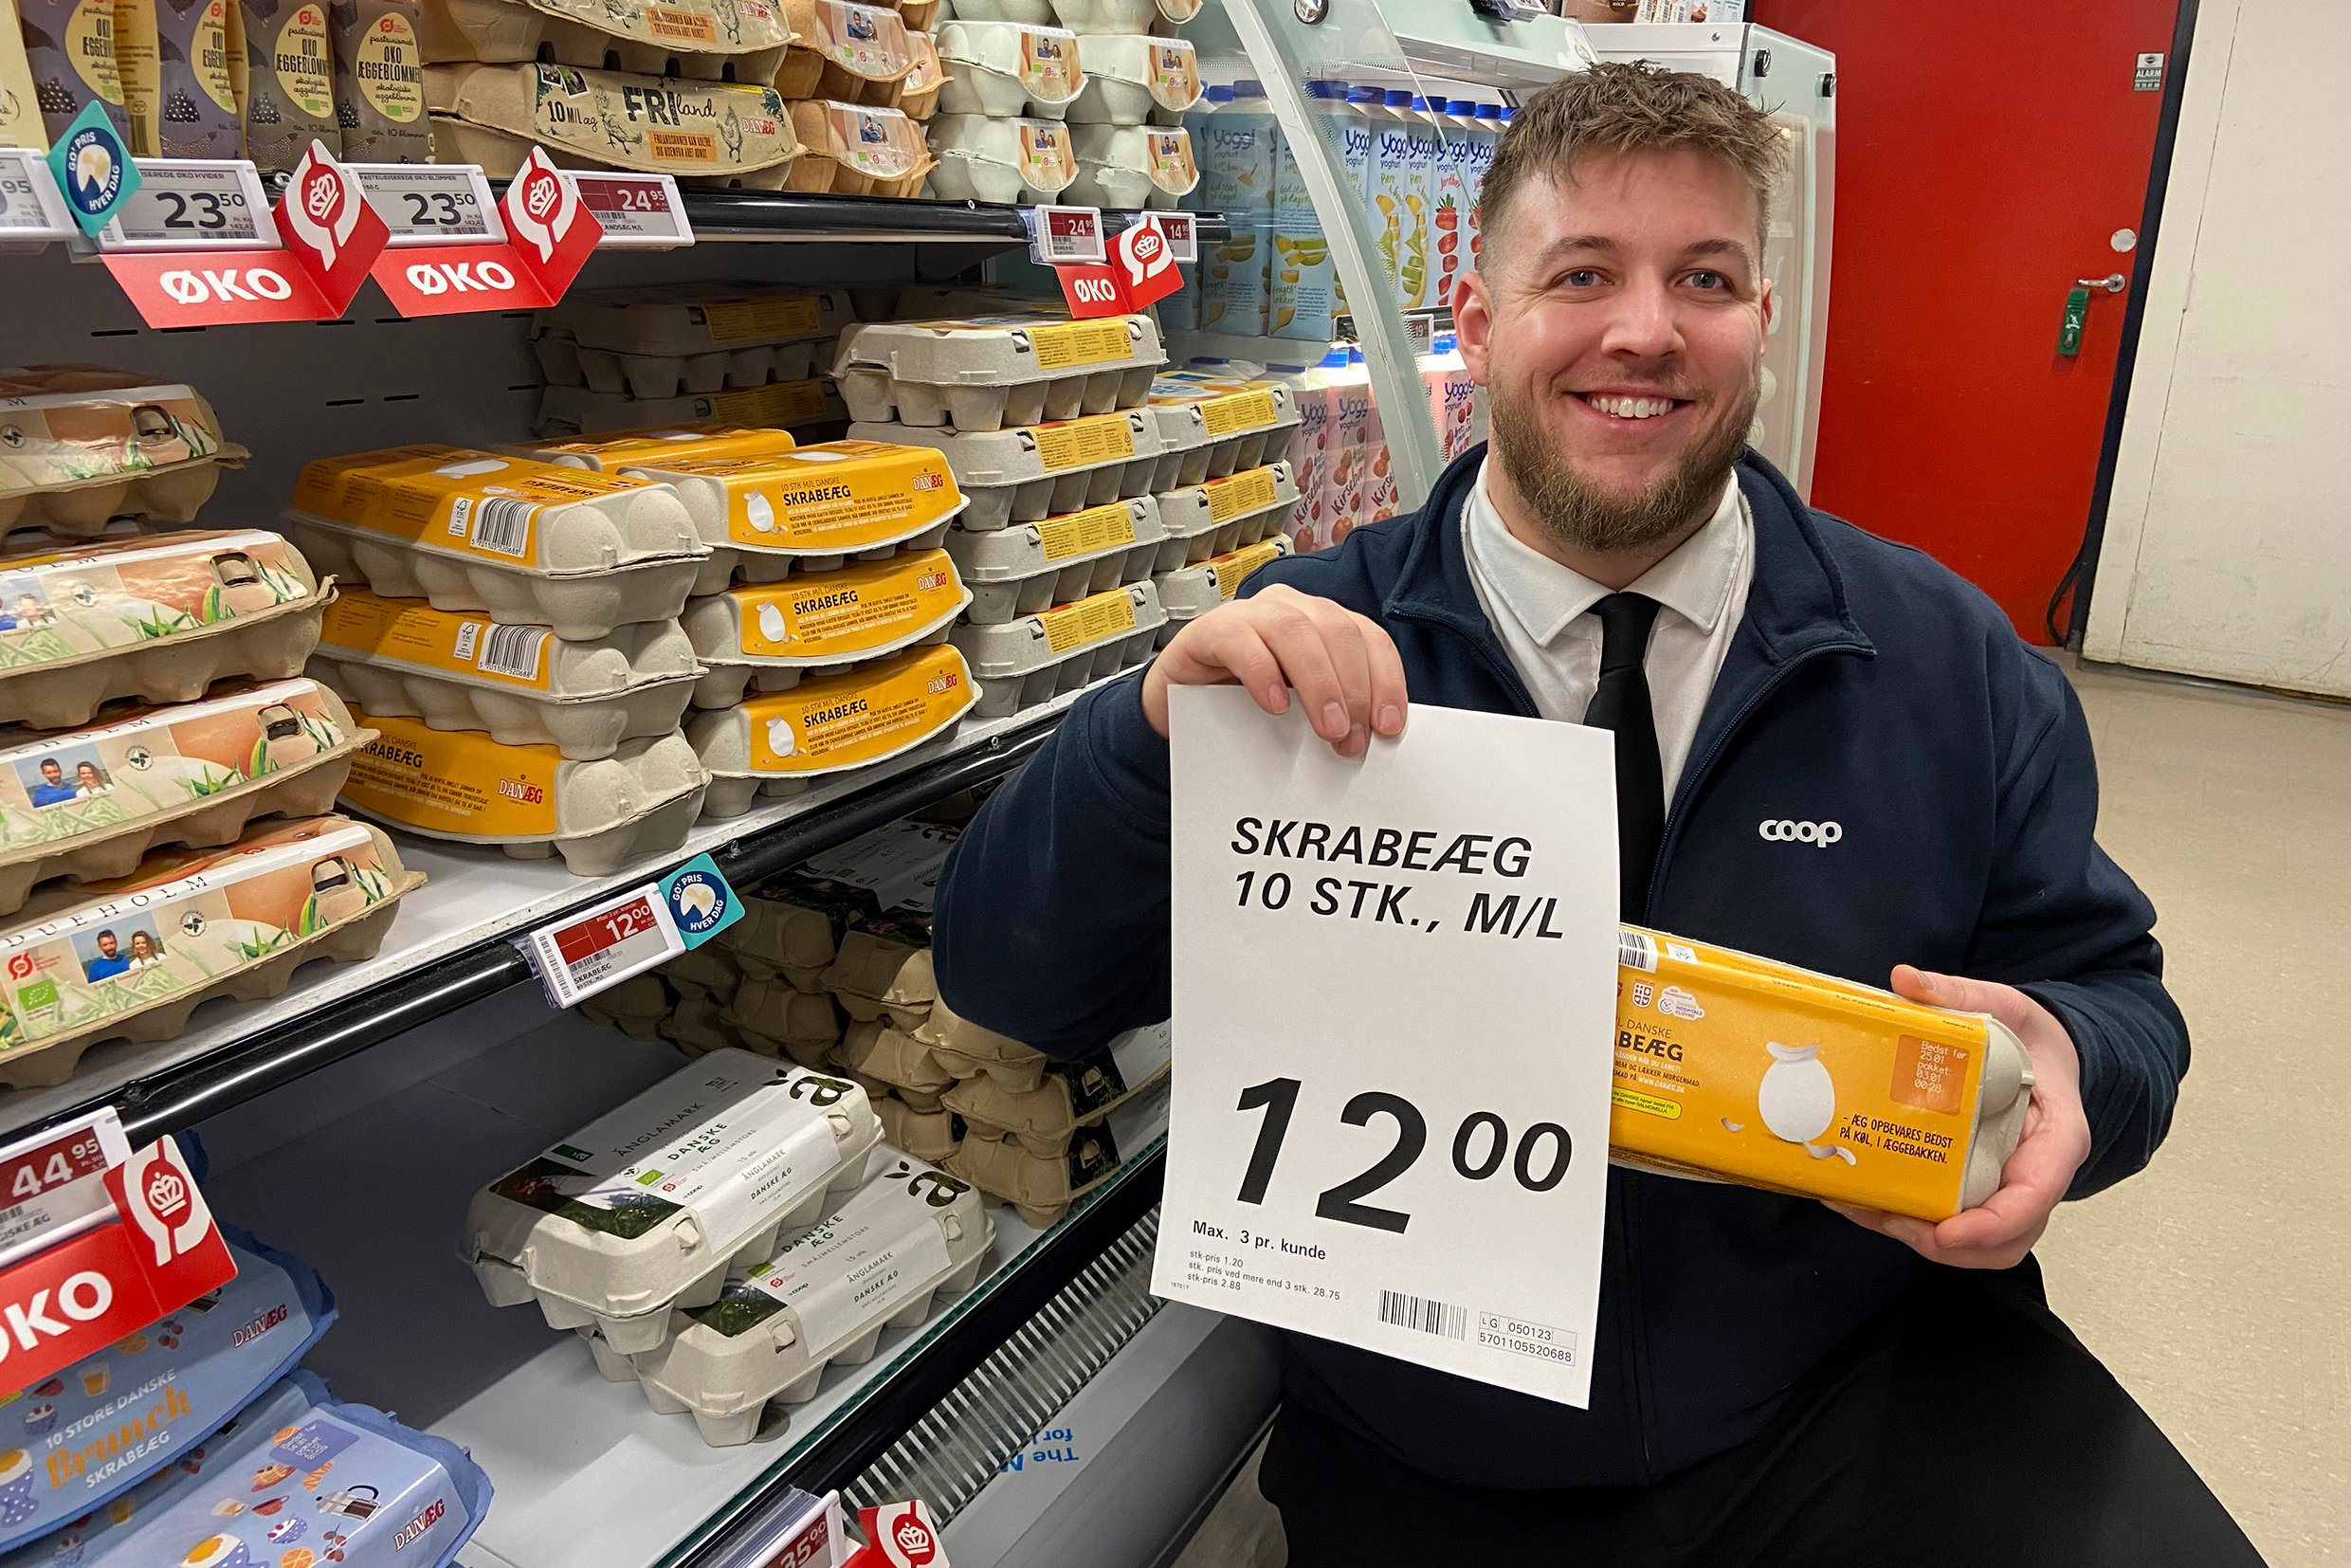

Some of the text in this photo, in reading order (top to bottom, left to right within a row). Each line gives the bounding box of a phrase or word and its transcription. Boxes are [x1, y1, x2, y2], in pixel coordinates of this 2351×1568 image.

[548, 101, 564, 122] 10
[740, 118, 775, 136] DANÆG
[75, 131, 96, 150] PRIS
[88, 191, 114, 212] HVER
[109, 164, 120, 191] DAG
[195, 172, 226, 180] HVIDER
[2, 180, 32, 194] 95
[616, 189, 652, 211] 24
[649, 190, 665, 202] 95
[155, 191, 246, 228] 23 50
[402, 192, 475, 226] 23 50
[1067, 219, 1086, 236] 24
[1170, 224, 1182, 240] 14
[159, 266, 293, 305] ØKO
[406, 261, 516, 296] ØKO
[1074, 278, 1117, 303] ØKO
[780, 483, 789, 492] 10
[815, 476, 842, 488] DANSKE
[783, 484, 851, 507] SKRABEÆG
[911, 473, 944, 491] DANÆG
[826, 582, 849, 595] DANSKE
[917, 572, 947, 591] DANÆG
[793, 590, 859, 615] SKRABEÆG
[927, 673, 957, 695] DANÆG
[801, 704, 810, 714] 10
[834, 691, 859, 706] DANSKE
[803, 699, 868, 728] SKRABEÆG
[392, 736, 418, 751] DANSKE
[498, 778, 544, 806] DANÆG
[1230, 817, 1533, 878] SKRABEÆG
[1759, 819, 1843, 848] coop
[4, 875, 209, 947] DUEHOLM
[672, 874, 724, 931] GO' PRIS HVER DAG
[1234, 870, 1565, 939] 10 STK., M/L
[606, 913, 639, 941] 12
[631, 904, 650, 920] 00
[574, 962, 612, 985] SKRABEÆG
[1627, 1019, 1673, 1039] DANSKE
[1614, 1030, 1684, 1063] BEÆG
[1921, 1040, 1949, 1056] Bedst
[1630, 1072, 1637, 1082] PÅ
[1638, 1066, 1662, 1078] LÆKKER
[666, 1122, 728, 1161] DANSKE
[1839, 1126, 1851, 1140] PÅ
[1853, 1130, 1873, 1148] KØL,
[1883, 1138, 1948, 1165] ÆGGEBAKKEN.
[1851, 1113, 1954, 1150] ÆG OPBEVARES BEDST
[697, 1138, 721, 1155] ÆG
[1235, 1076, 1574, 1235] 12 00
[11, 1152, 74, 1197] 44
[71, 1139, 100, 1160] 95
[750, 1175, 779, 1200] DANSKE
[781, 1166, 793, 1179] ÆG
[33, 1213, 51, 1228] ÆG
[780, 1214, 845, 1253] DANSKE
[811, 1231, 835, 1249] ÆG
[1193, 1219, 1327, 1261] Max. 3 pr. kunde
[1190, 1249, 1244, 1268] stk-pris 1.20
[854, 1279, 885, 1304] DANSKE
[886, 1269, 900, 1283] ÆG
[1187, 1272, 1242, 1291] stk-pris 2.88
[1189, 1261, 1341, 1301] stk. pris ved mere end 3 stk. 28.75
[230, 1304, 288, 1349] DANÆG
[1489, 1318, 1498, 1329] G
[1508, 1322, 1552, 1341] 050123
[1479, 1331, 1573, 1362] 5701105520688
[46, 1367, 177, 1449] 10 STORE DANSKE
[46, 1384, 193, 1490] Brunch
[1043, 1428, 1074, 1442] for
[85, 1430, 171, 1488] SKRABEÆG
[1032, 1447, 1080, 1463] The
[392, 1498, 447, 1552] DANÆG
[780, 1521, 827, 1568] 35 00
